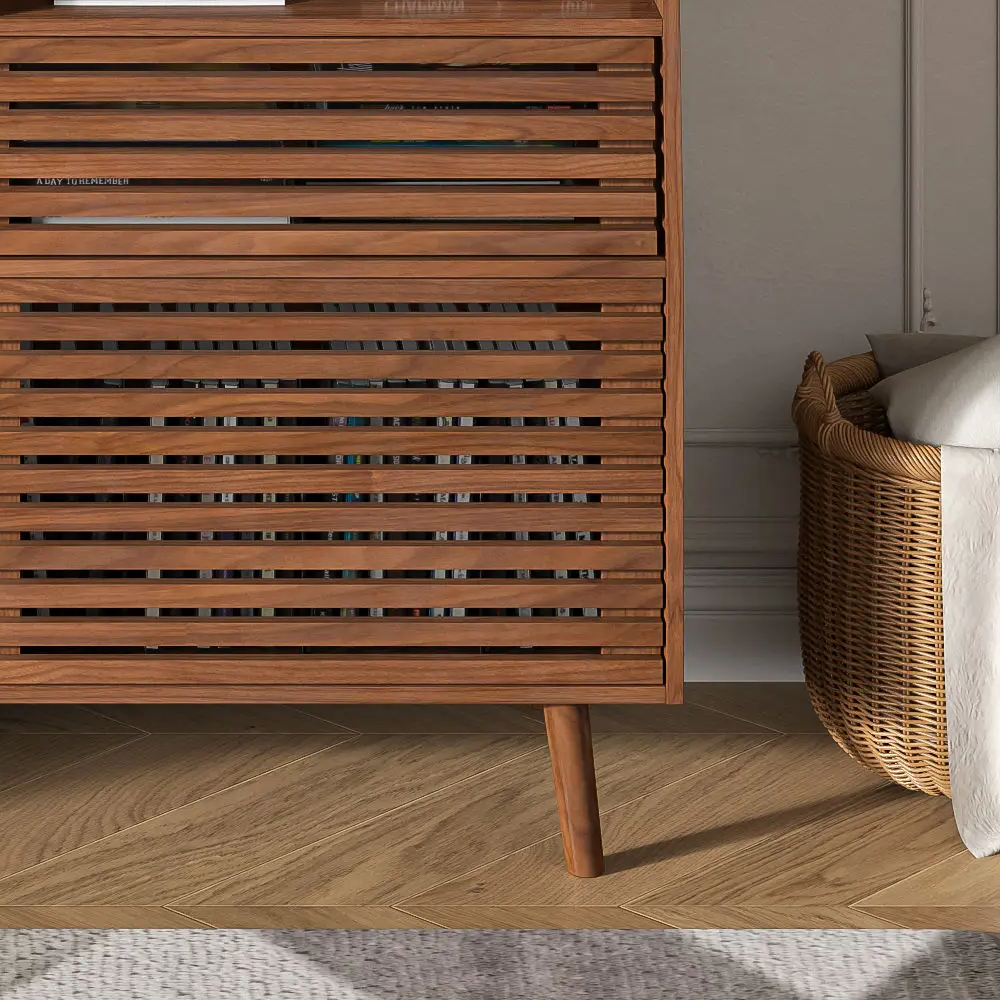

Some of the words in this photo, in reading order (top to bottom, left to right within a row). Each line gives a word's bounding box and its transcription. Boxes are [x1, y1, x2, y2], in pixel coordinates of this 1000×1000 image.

[37, 178, 43, 186] A
[44, 178, 63, 186] DAY
[78, 178, 129, 186] REMEMBER
